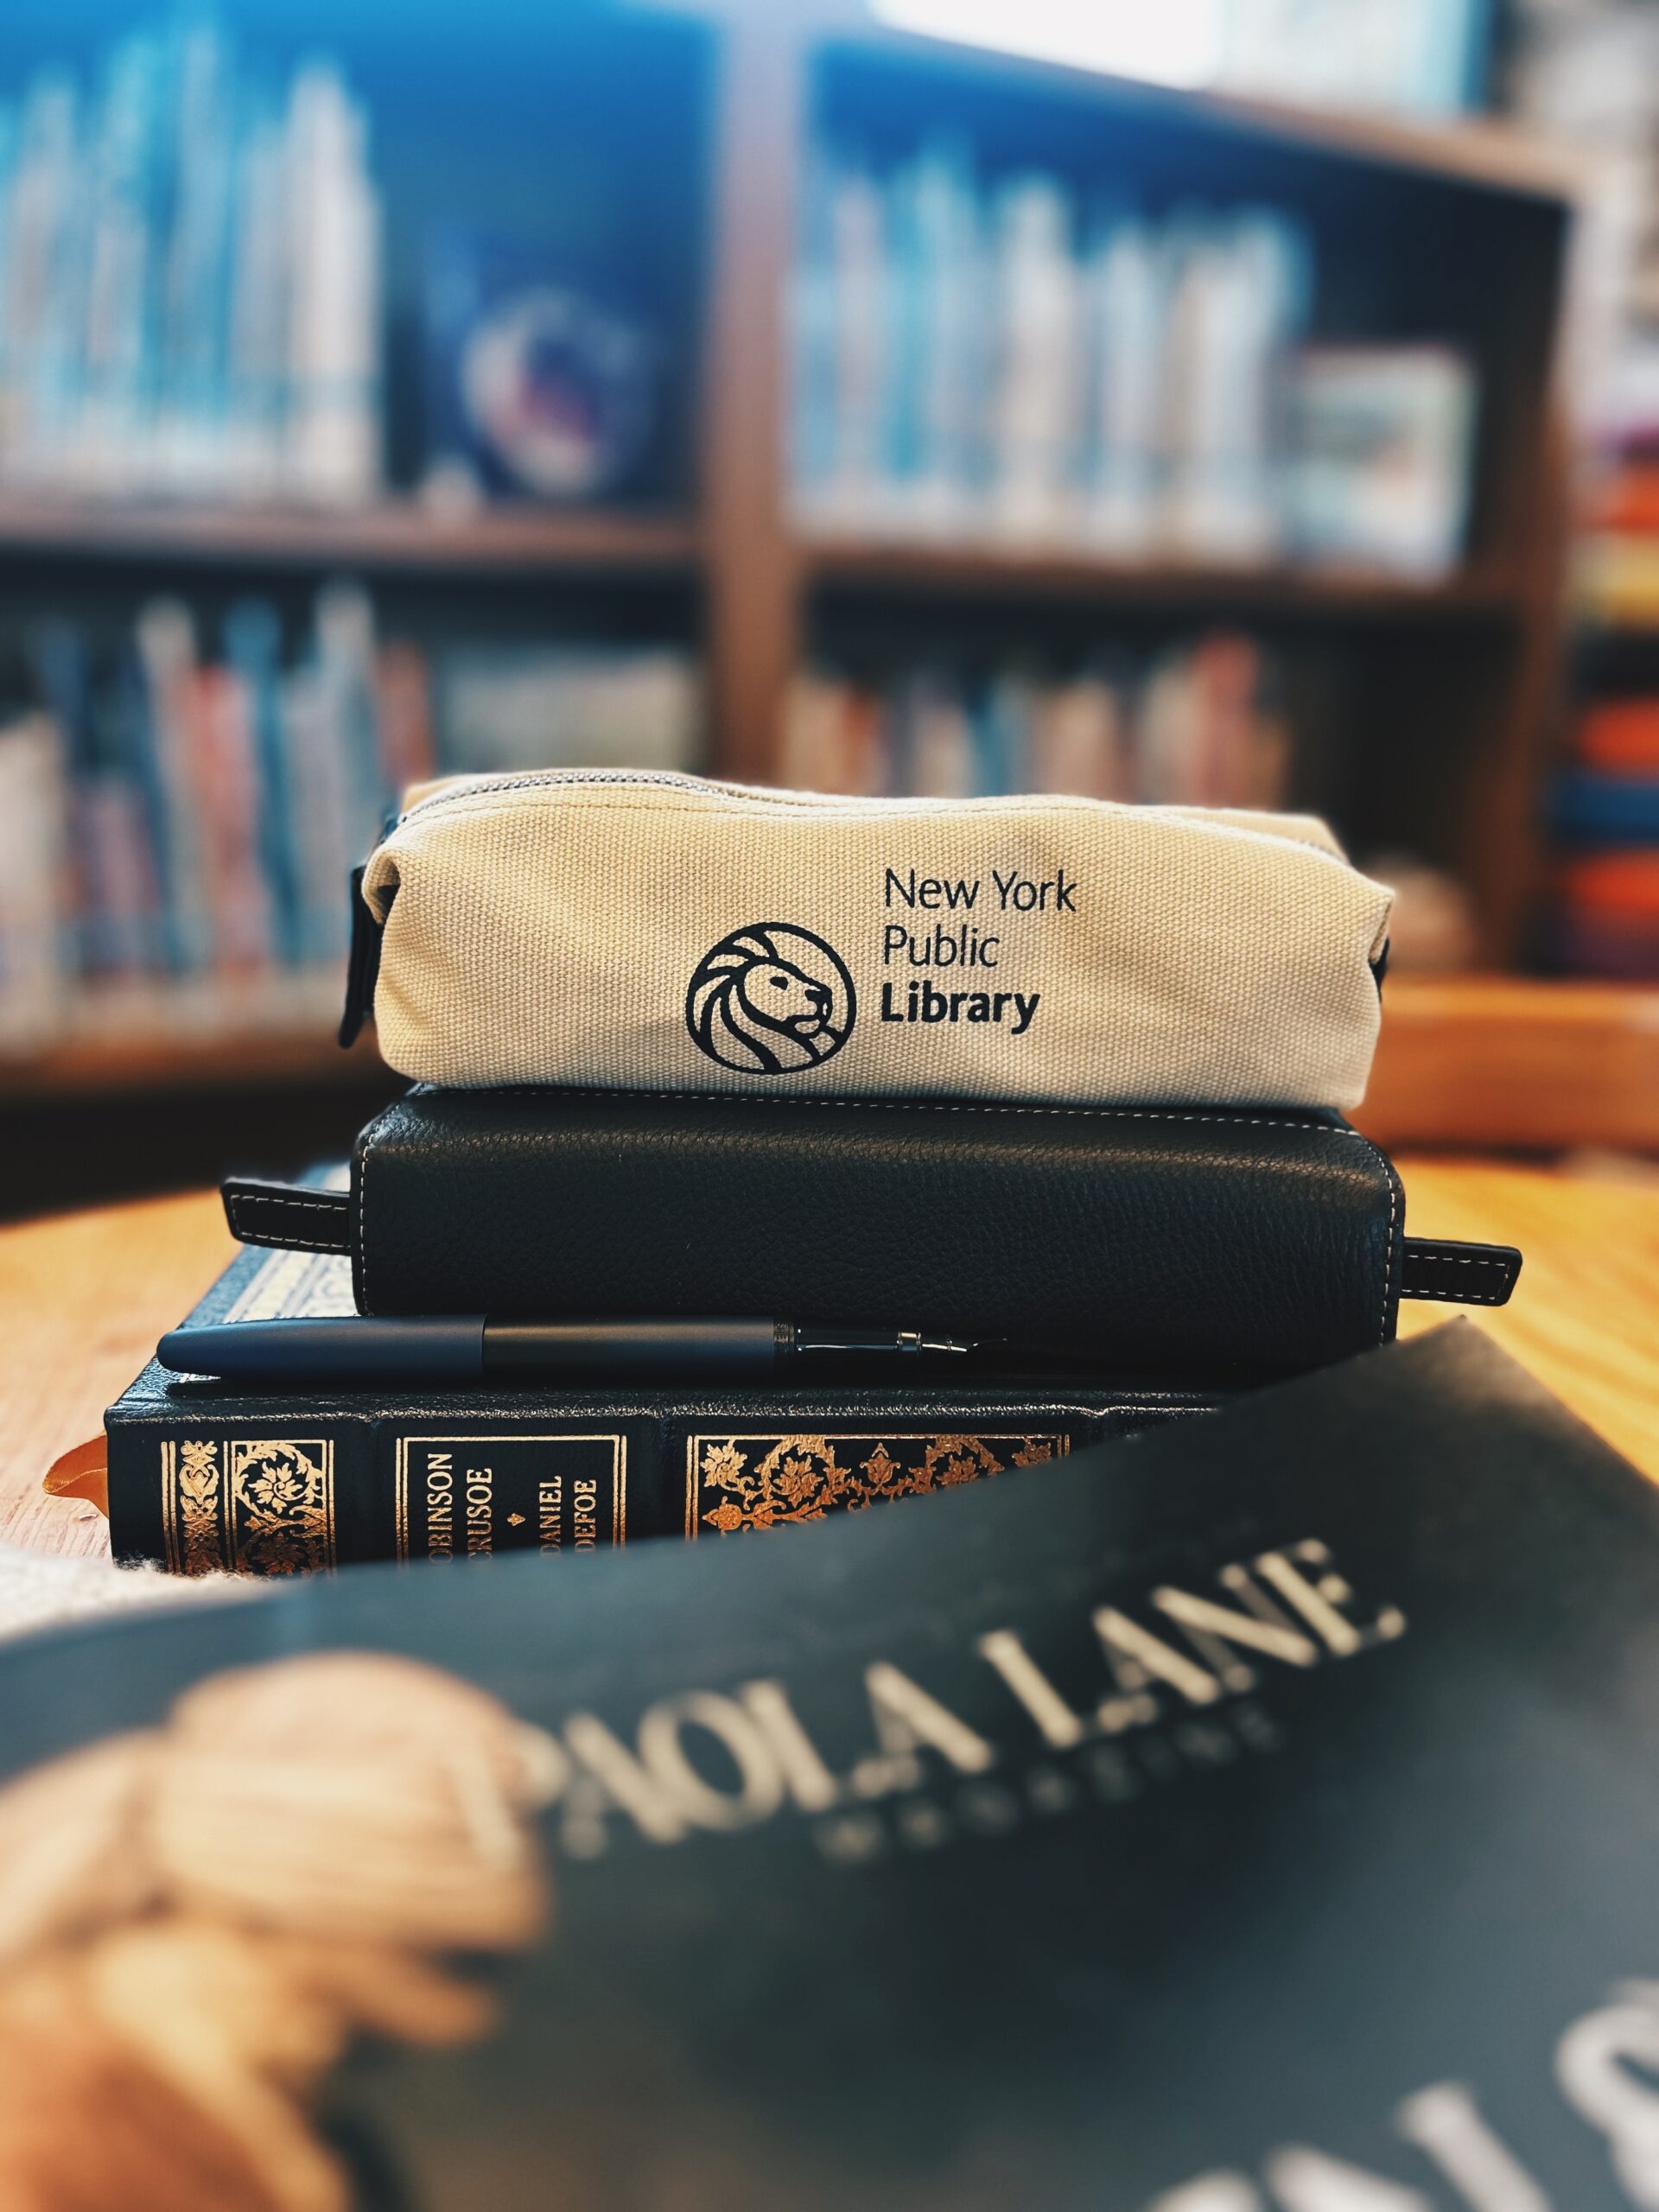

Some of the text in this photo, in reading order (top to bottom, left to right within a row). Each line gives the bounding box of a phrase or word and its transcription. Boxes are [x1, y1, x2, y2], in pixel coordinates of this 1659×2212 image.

[885, 868, 1077, 912] New York
[884, 923, 1001, 968] Public
[880, 979, 1041, 1035] Library
[427, 1452, 453, 1565] OBINSON
[466, 1467, 493, 1563] CRUSOE
[538, 1474, 563, 1558] DANIEL
[573, 1478, 597, 1553] DEFOE
[978, 1536, 1408, 1751] LANE
